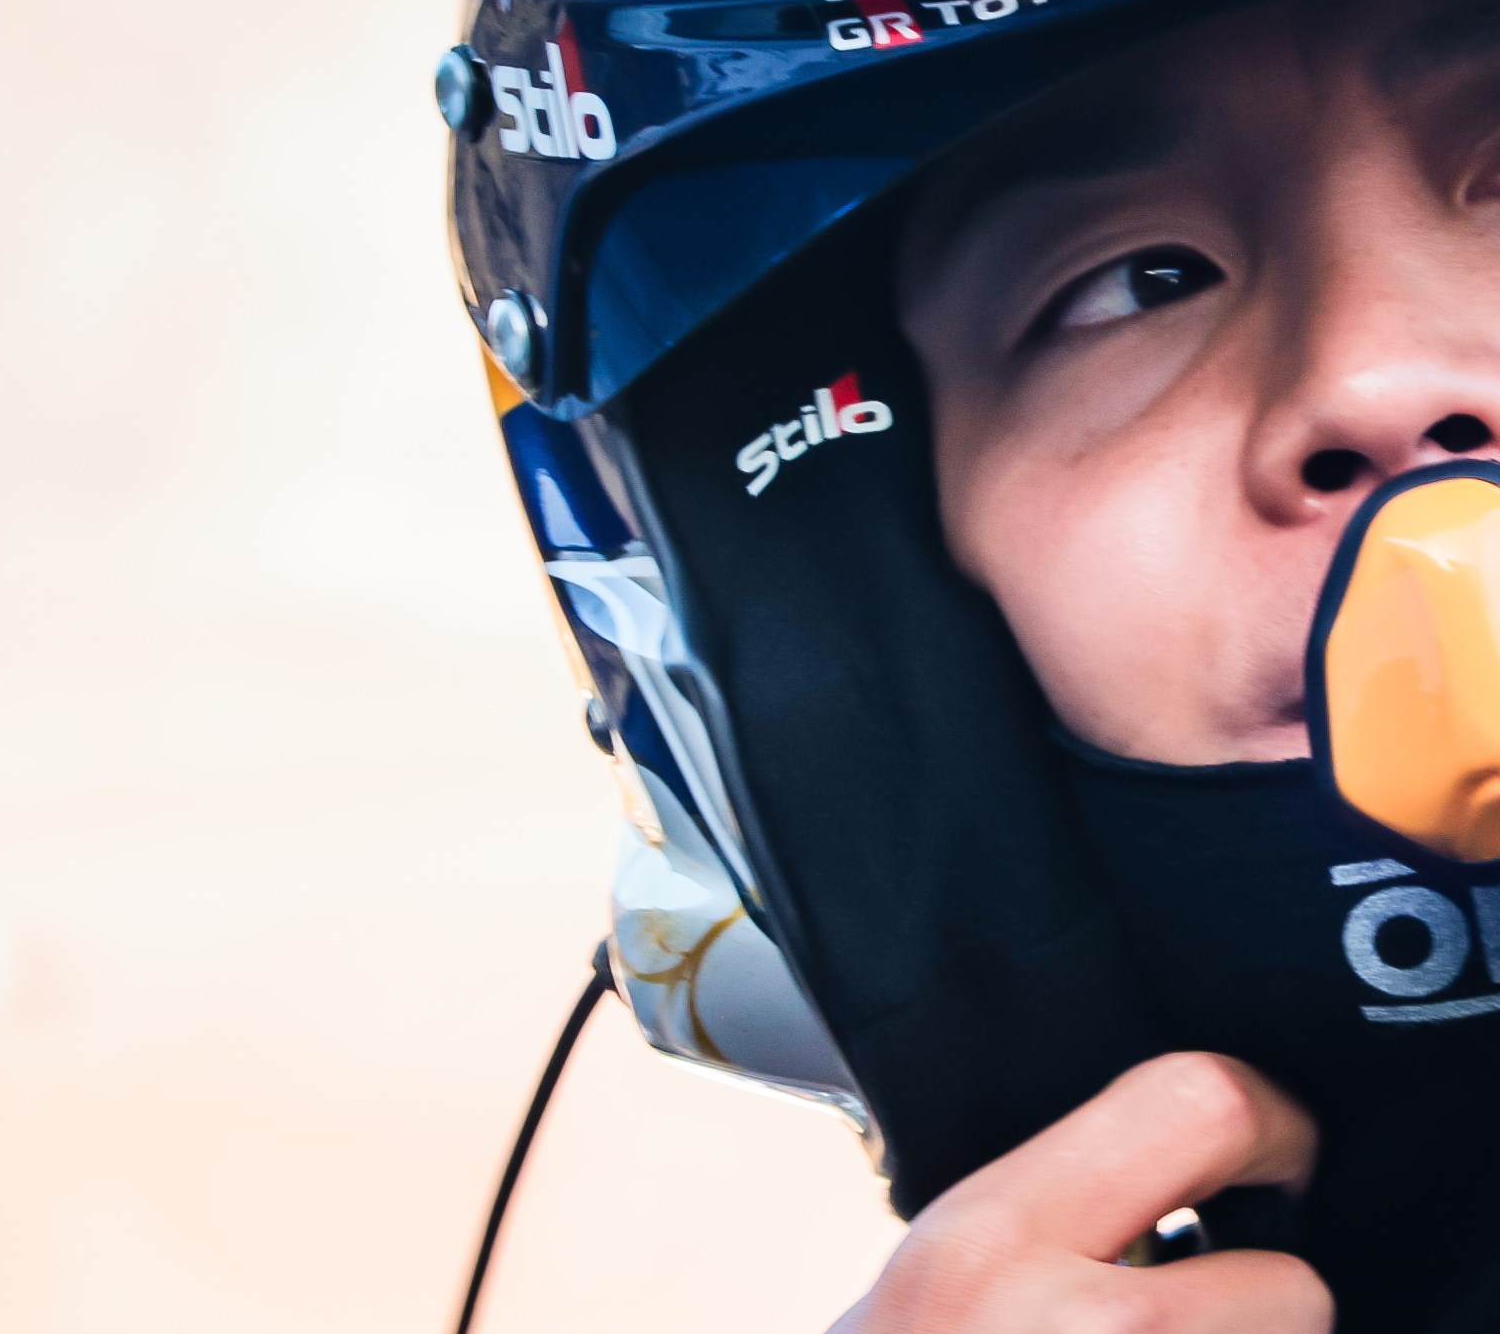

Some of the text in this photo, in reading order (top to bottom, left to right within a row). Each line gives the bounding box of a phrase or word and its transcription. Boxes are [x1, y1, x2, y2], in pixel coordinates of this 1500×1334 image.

[826, 9, 923, 52] GR
[493, 41, 617, 162] Stilo
[736, 386, 894, 497] Stilo
